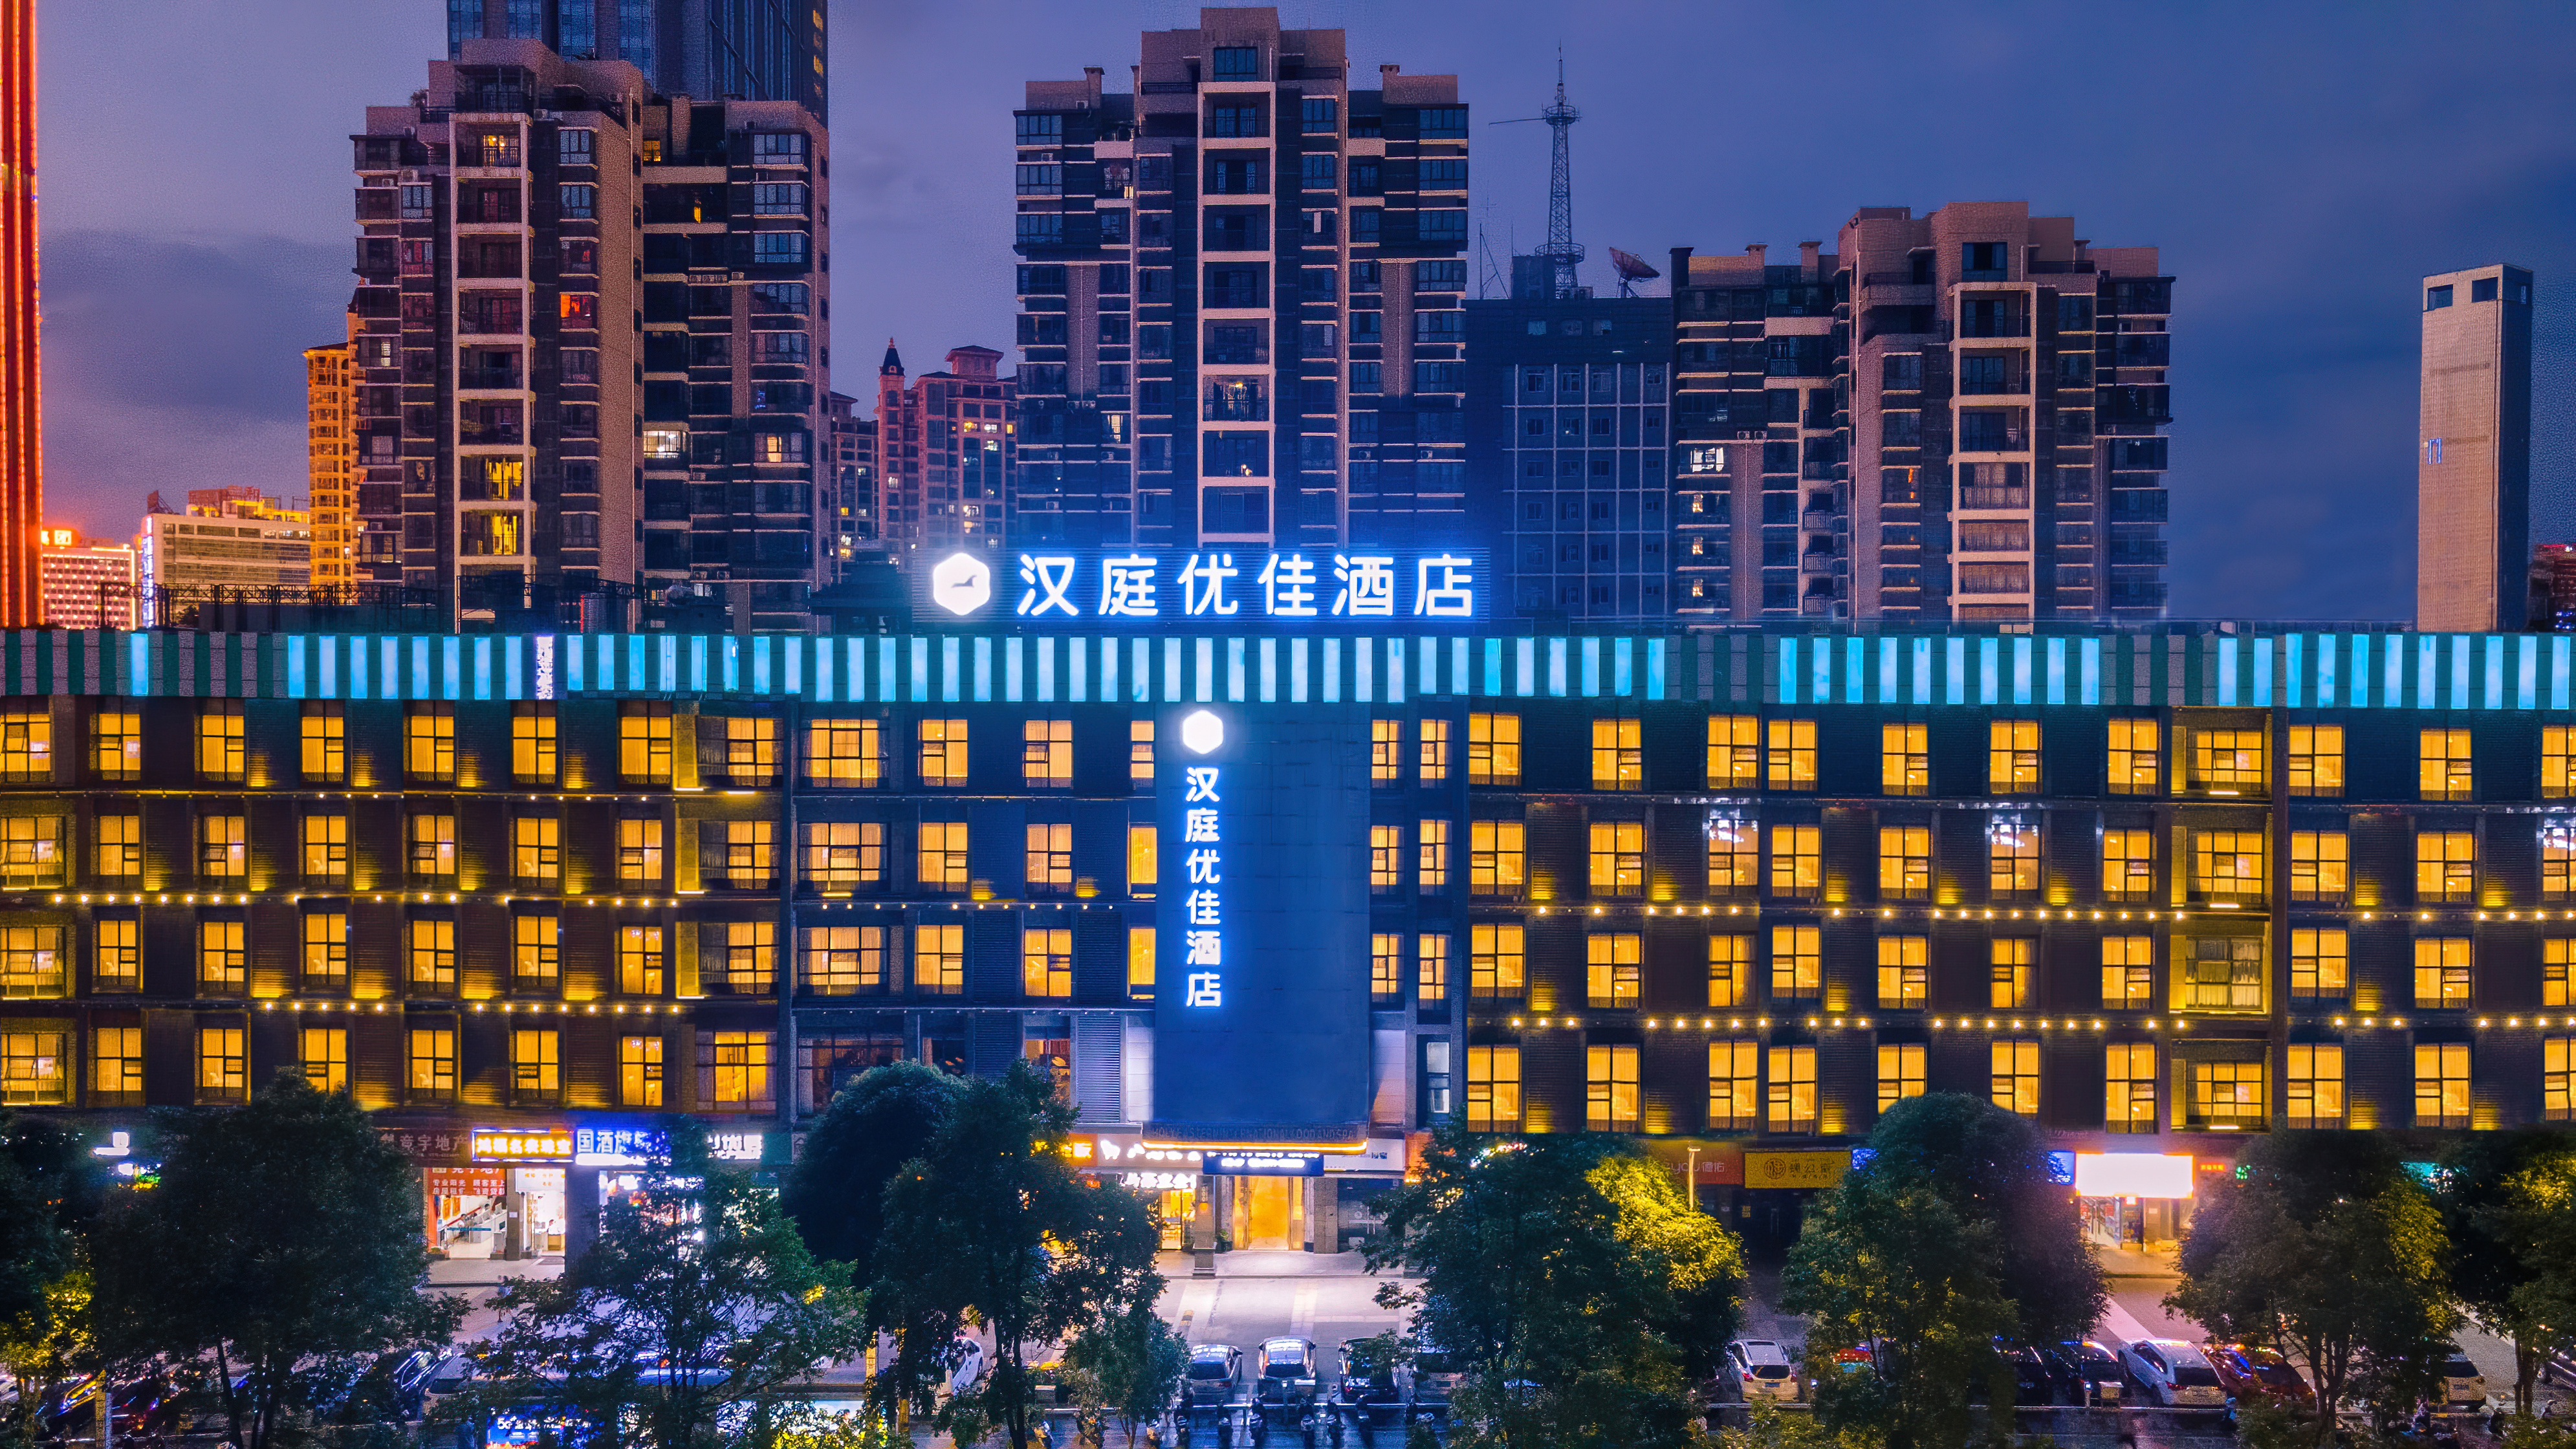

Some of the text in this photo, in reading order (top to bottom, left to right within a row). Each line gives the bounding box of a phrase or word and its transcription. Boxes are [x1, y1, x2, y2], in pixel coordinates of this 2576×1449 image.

[1016, 553, 1474, 618] 汉庭优佳酒店
[1184, 766, 1222, 1008] 汉庭优佳酒店
